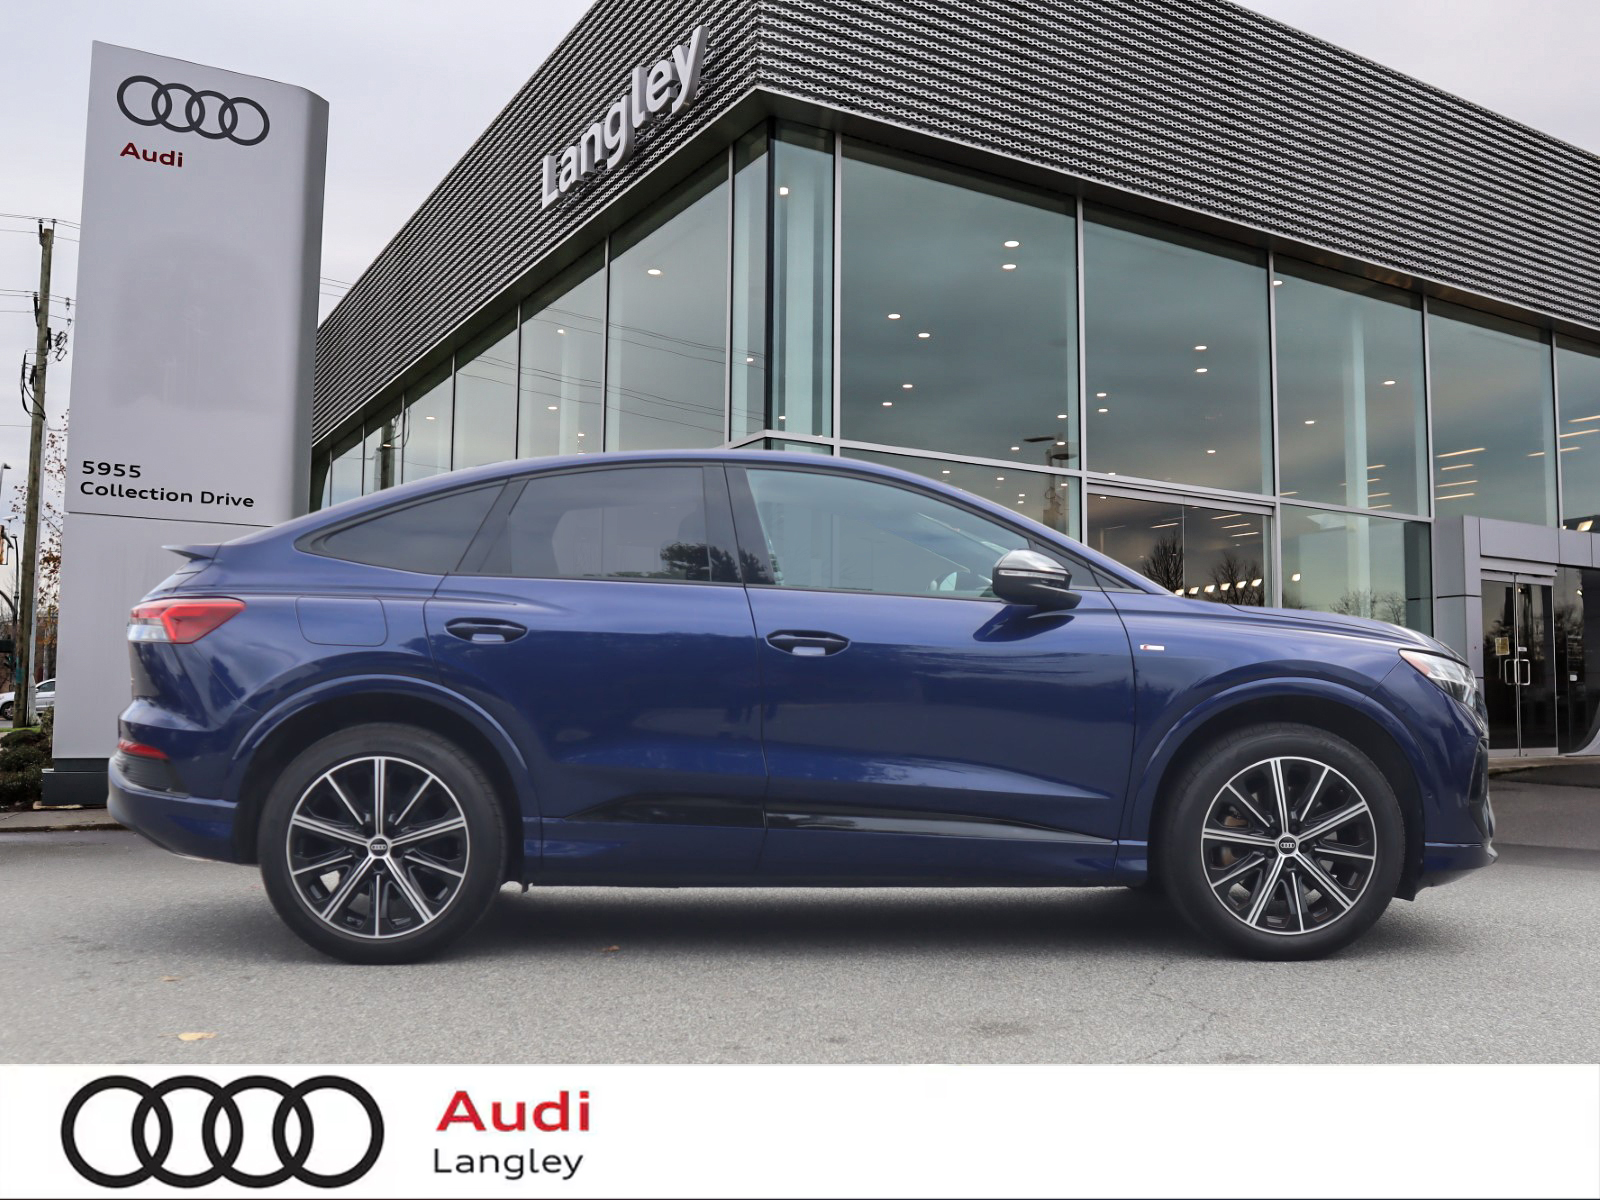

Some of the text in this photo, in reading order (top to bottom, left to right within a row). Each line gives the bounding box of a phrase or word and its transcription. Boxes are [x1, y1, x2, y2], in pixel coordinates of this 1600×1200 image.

[541, 24, 711, 211] Langley
[119, 142, 184, 168] Audi
[81, 460, 142, 479] 5955
[79, 481, 255, 508] Collection Drive
